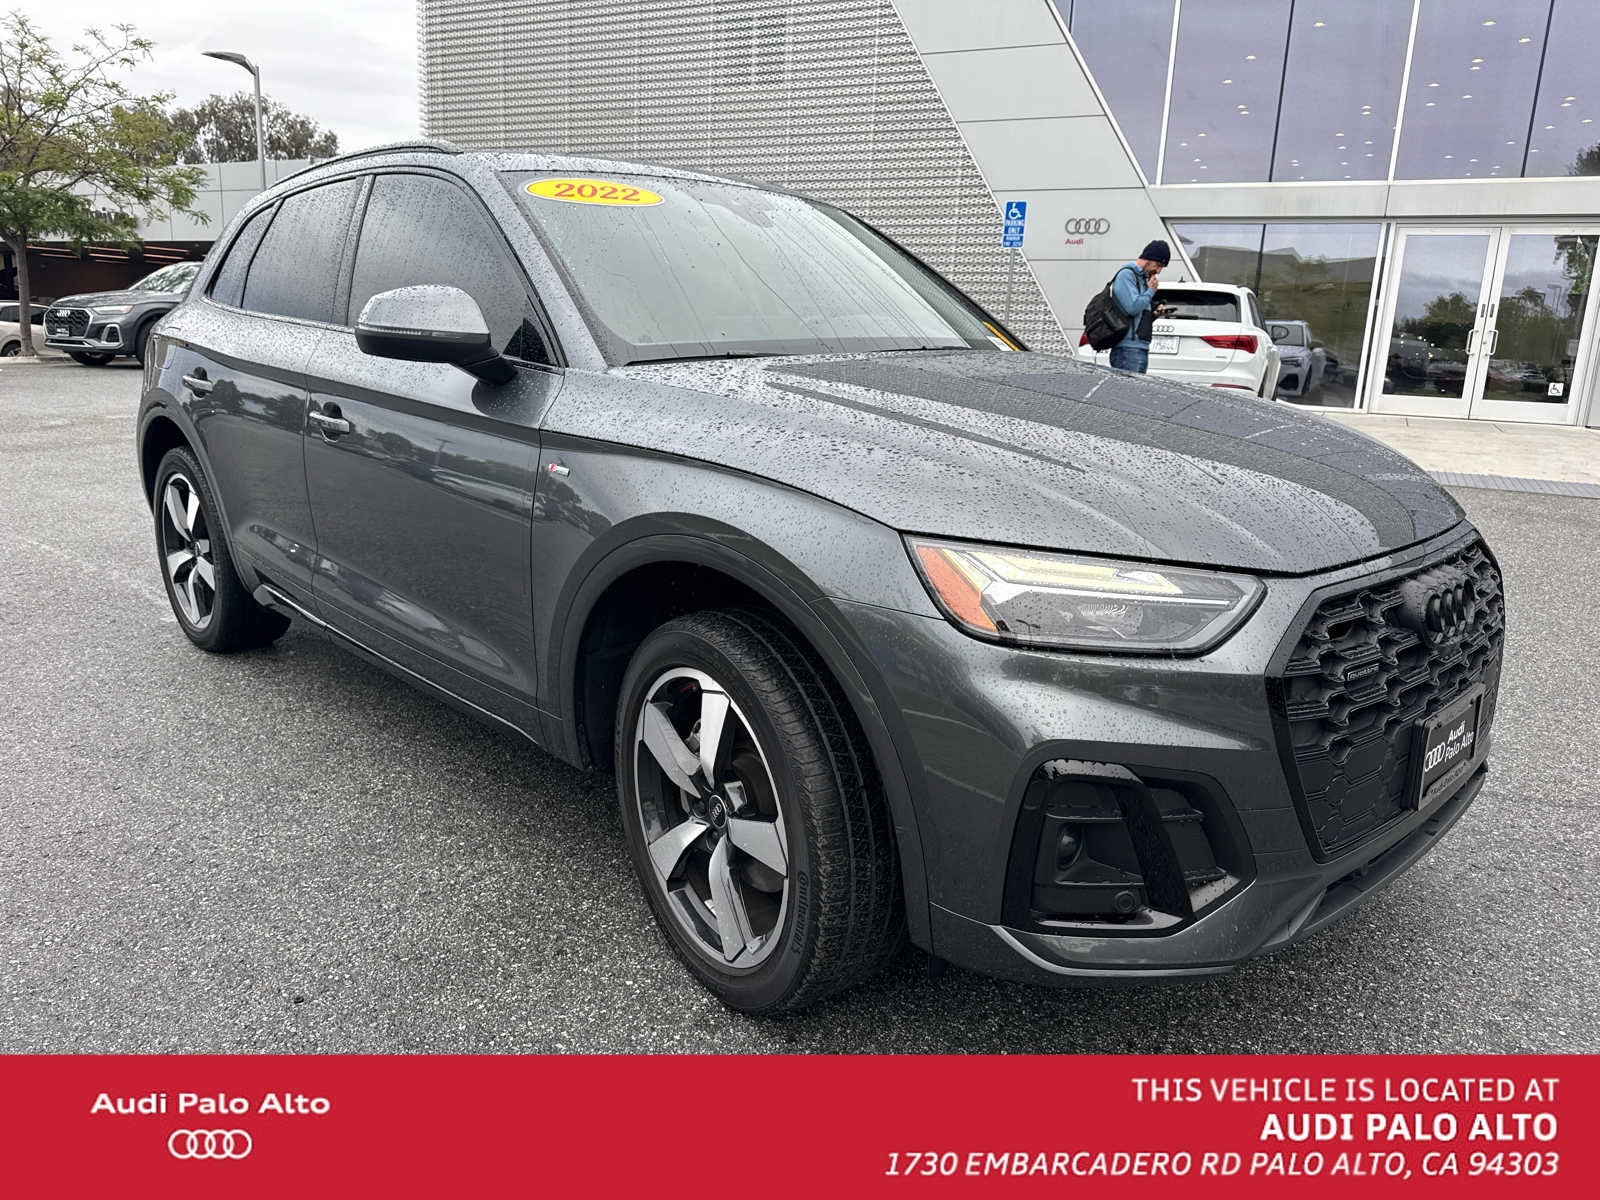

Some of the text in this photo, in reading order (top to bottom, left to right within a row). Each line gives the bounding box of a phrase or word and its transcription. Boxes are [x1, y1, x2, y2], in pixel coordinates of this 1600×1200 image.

[554, 183, 641, 202] 2022
[1447, 720, 1465, 744] Audi
[1445, 731, 1475, 762] Palo Alto
